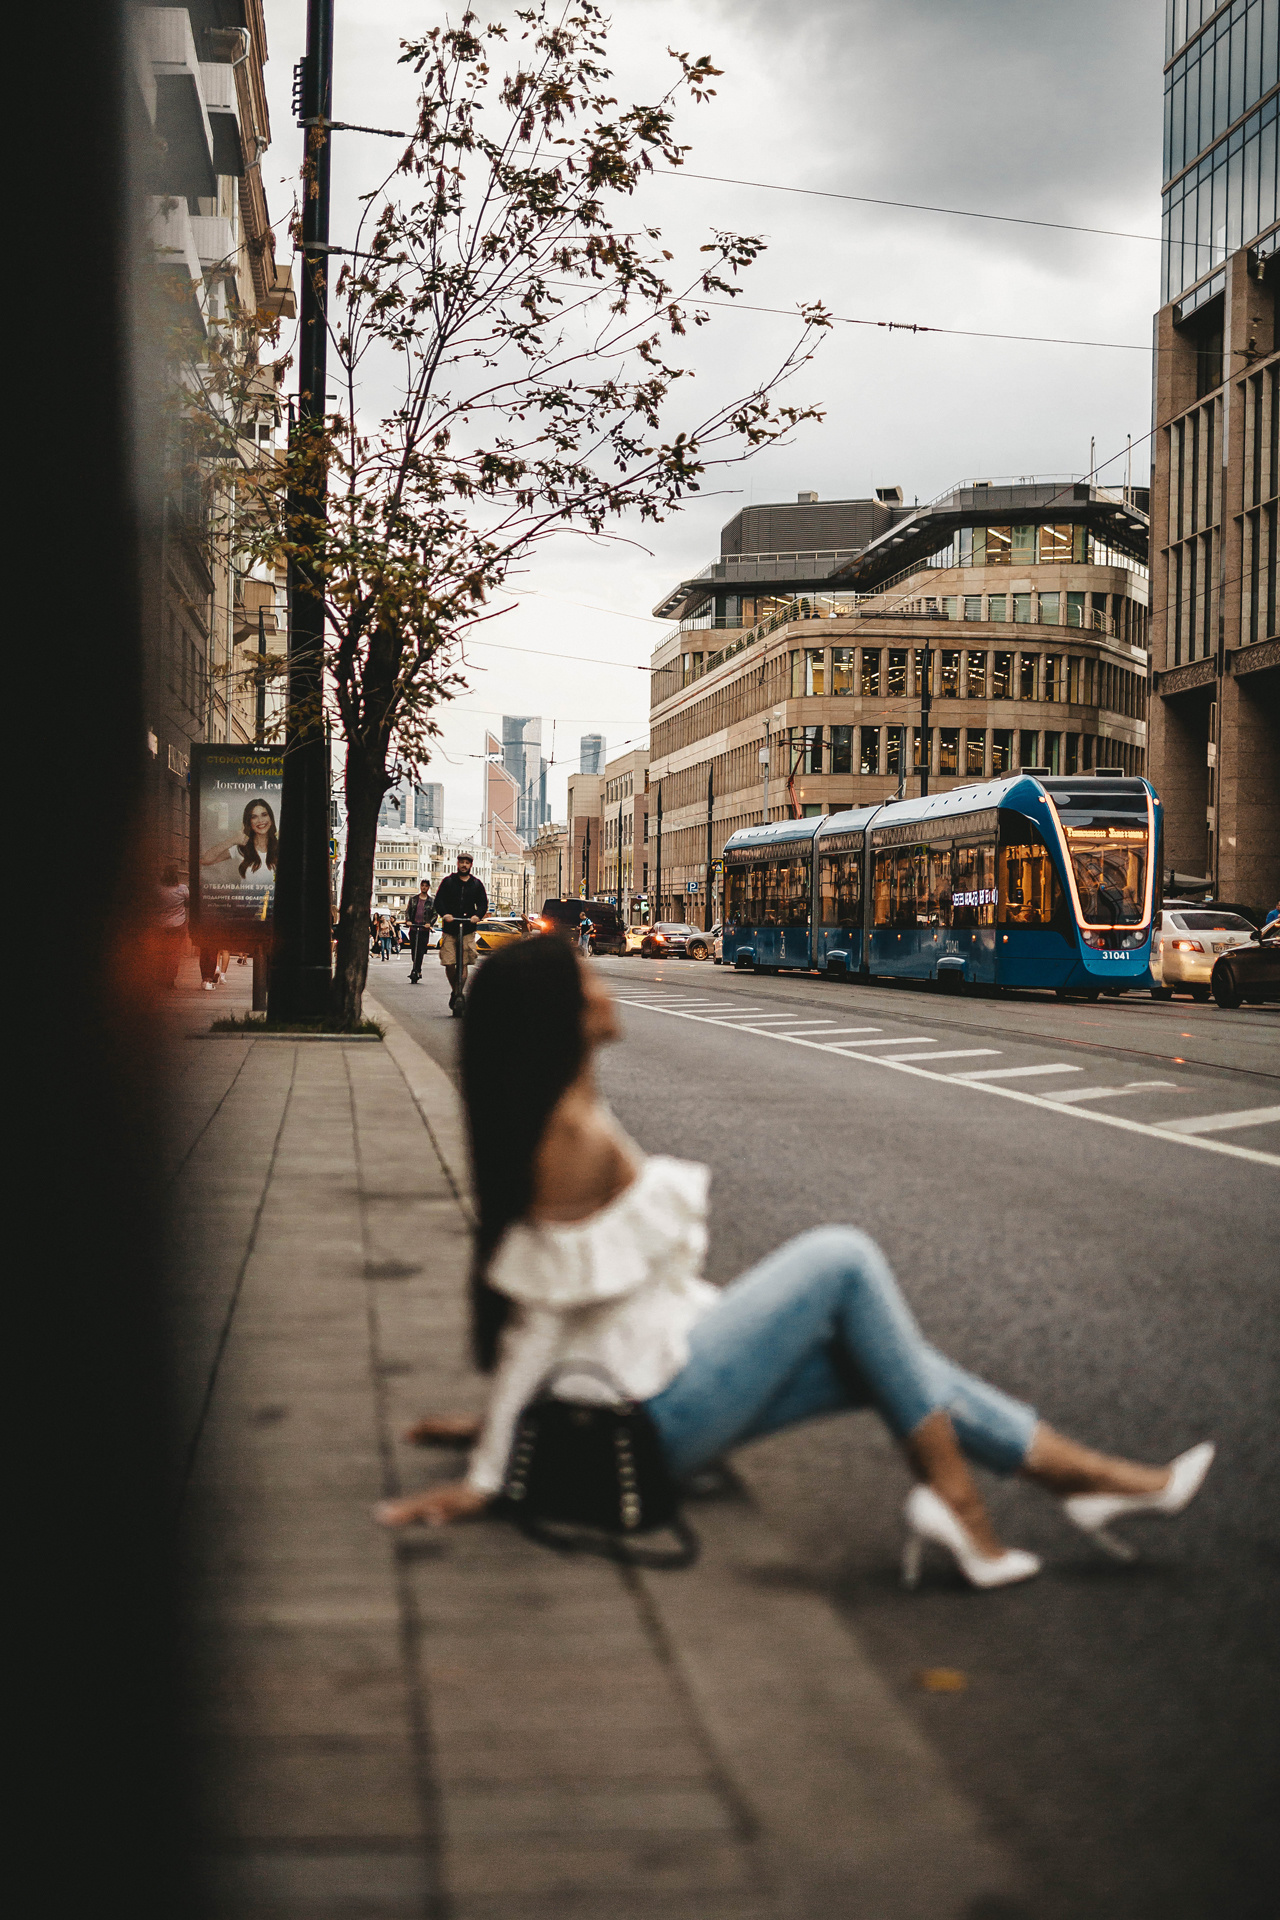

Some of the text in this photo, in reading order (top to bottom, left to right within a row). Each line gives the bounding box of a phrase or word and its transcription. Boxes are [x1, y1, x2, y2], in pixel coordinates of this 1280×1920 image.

[238, 768, 283, 776] КЛИНИКА
[213, 780, 256, 792] Доктора
[1102, 951, 1130, 960] 31041
